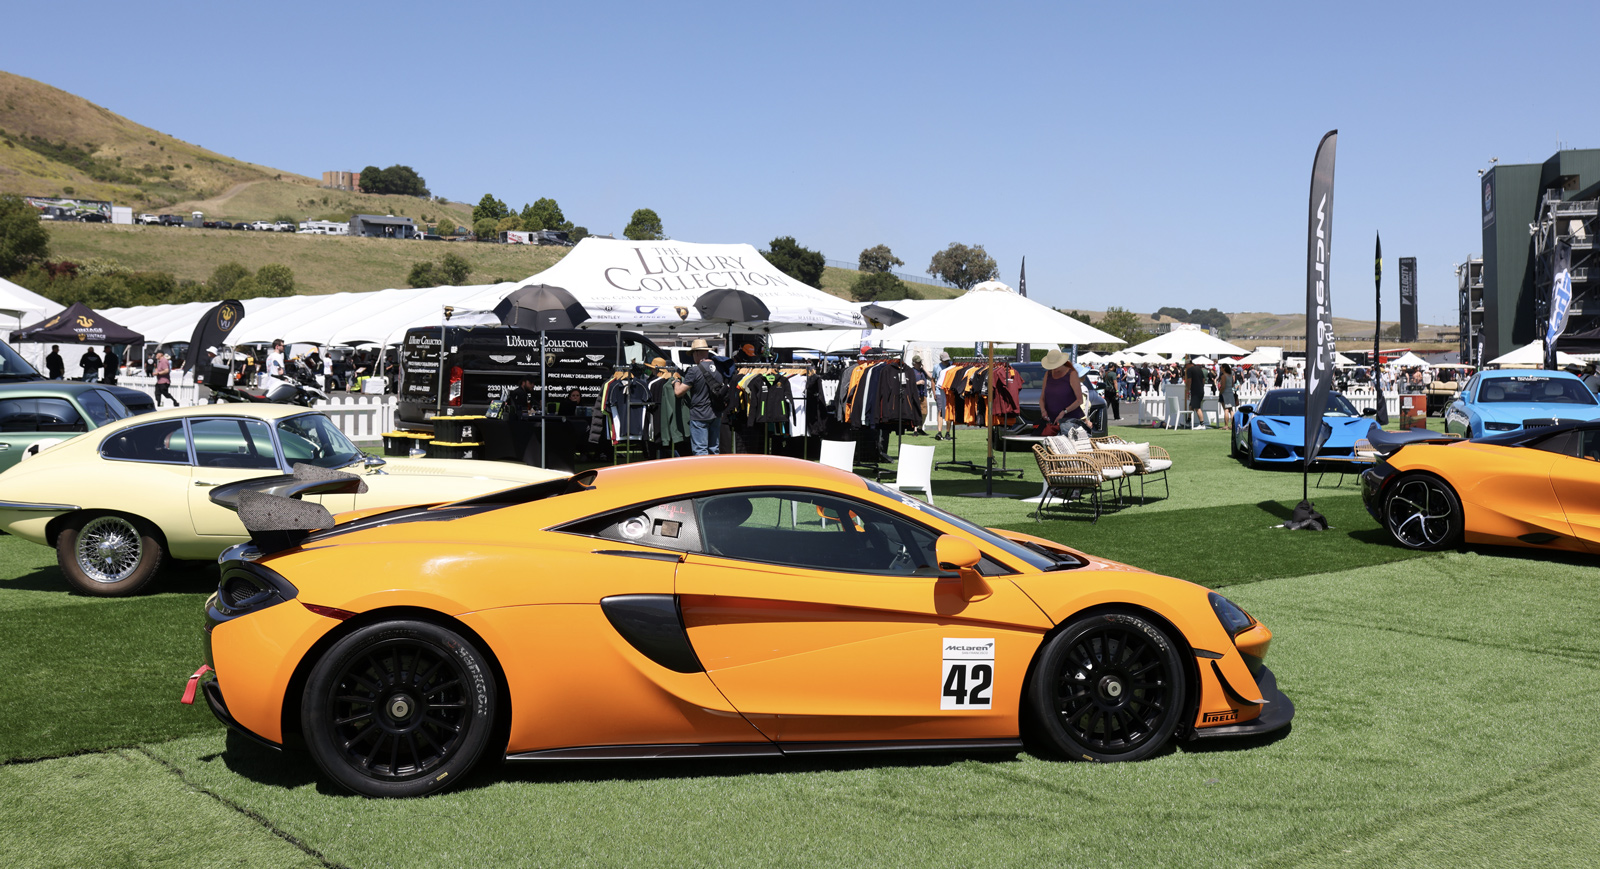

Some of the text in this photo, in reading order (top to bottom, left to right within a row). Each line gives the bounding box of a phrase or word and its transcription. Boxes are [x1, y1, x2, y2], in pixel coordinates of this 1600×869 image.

[633, 247, 747, 275] LUXURY
[652, 247, 683, 256] THE
[604, 267, 789, 292] COLLECTION
[1401, 265, 1409, 296] VELOCITY
[506, 335, 538, 347] LUXURY
[943, 664, 992, 705] 42
[1202, 709, 1239, 723] PIRELLI
